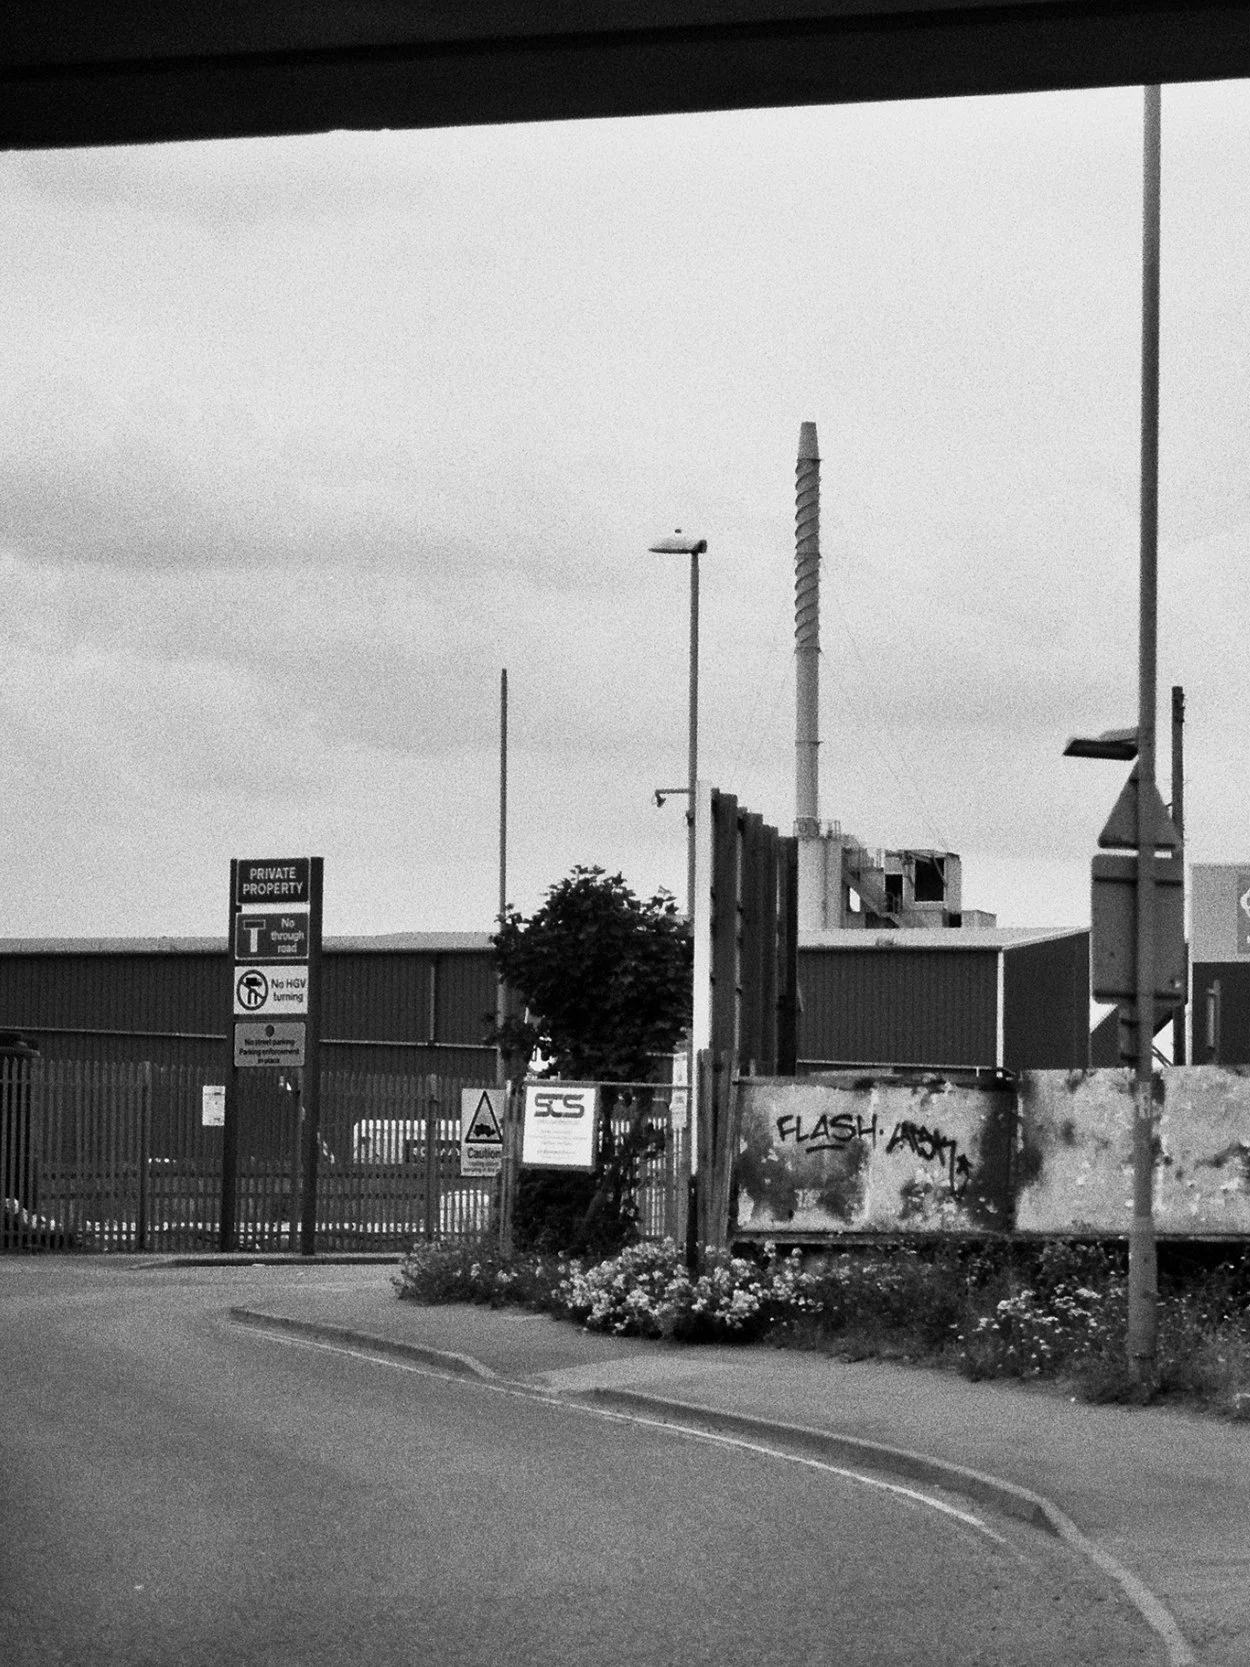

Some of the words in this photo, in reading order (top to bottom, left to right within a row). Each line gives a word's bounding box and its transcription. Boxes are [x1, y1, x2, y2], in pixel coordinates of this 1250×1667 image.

[249, 866, 297, 880] PRIVATE
[242, 881, 304, 895] PROPERTY
[281, 918, 295, 928] No
[270, 930, 305, 942] through
[277, 942, 298, 953] road
[271, 979, 285, 989] No
[286, 978, 307, 989] HGV
[273, 992, 304, 1003] turning
[534, 1093, 585, 1118] SCS
[467, 1147, 501, 1159] Caution
